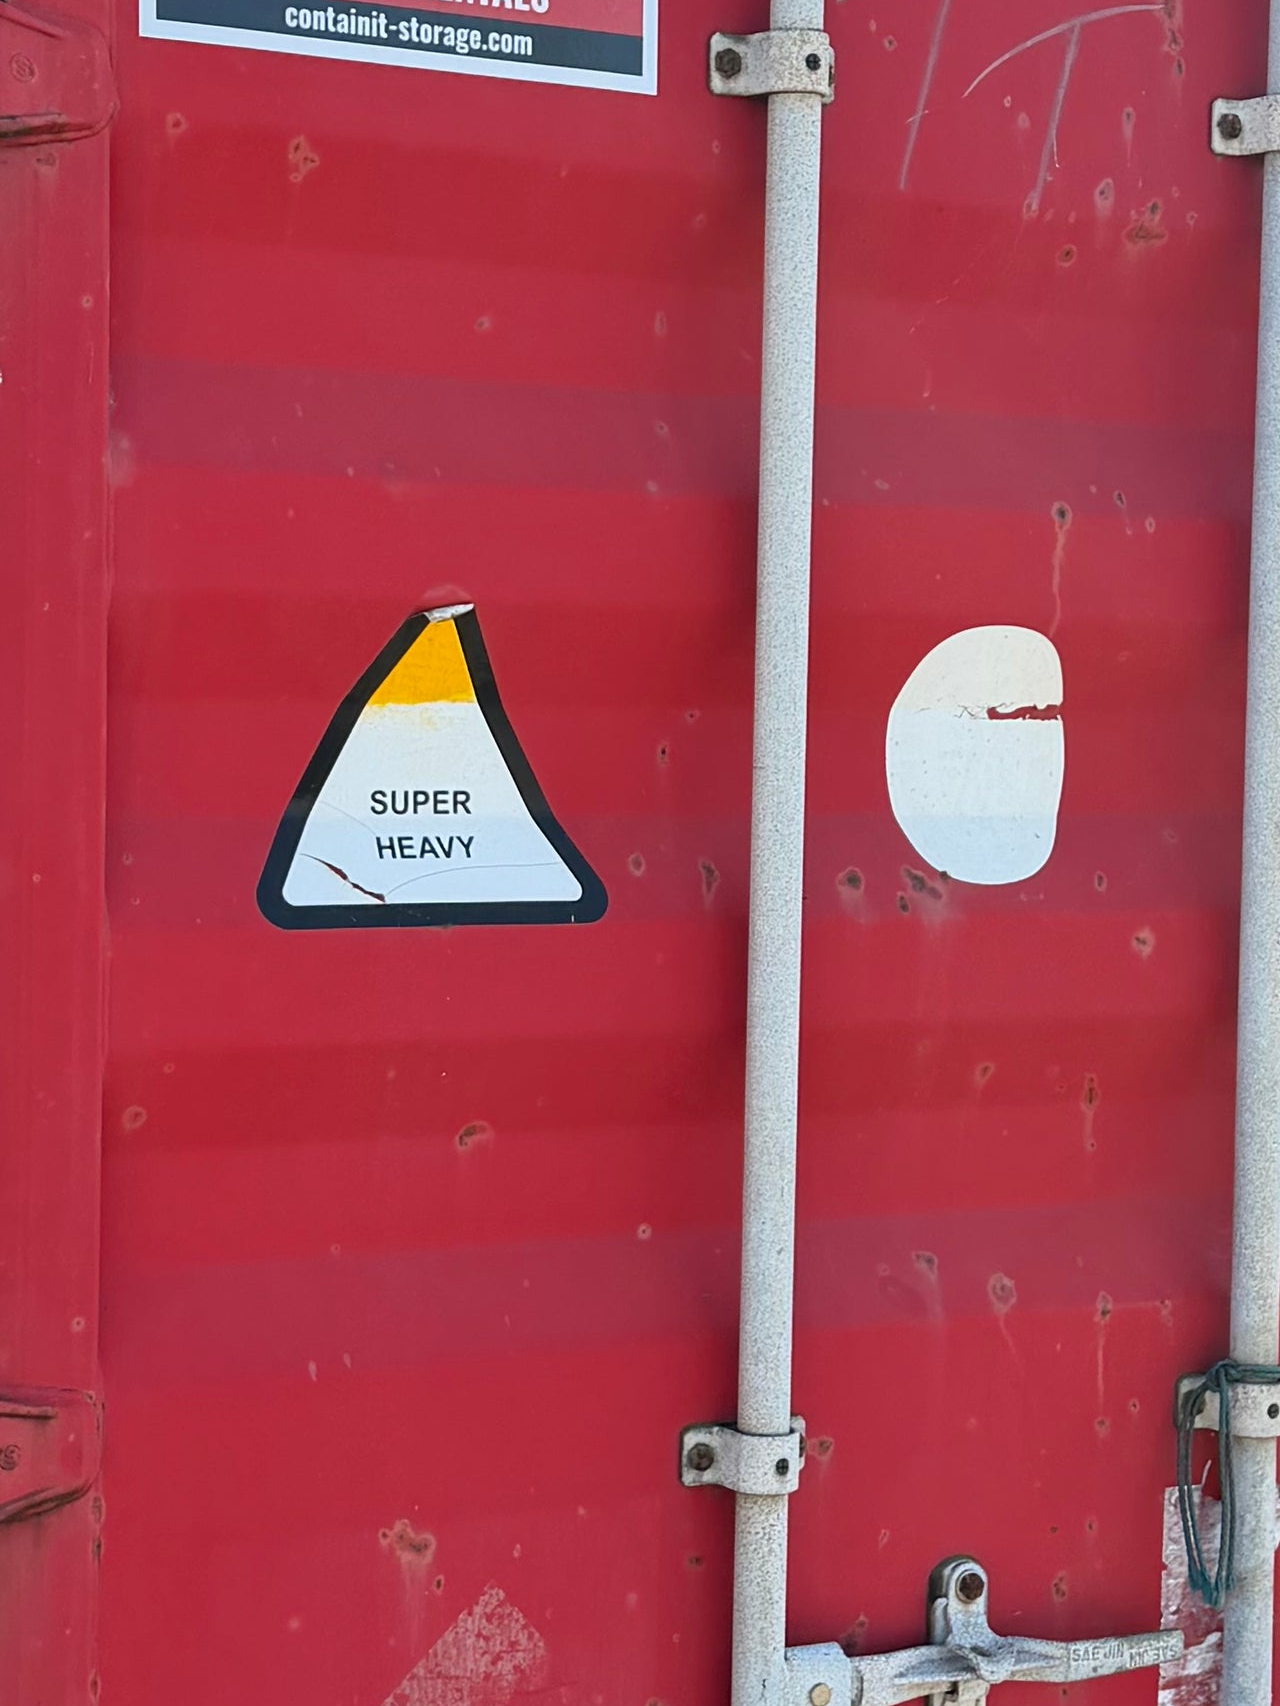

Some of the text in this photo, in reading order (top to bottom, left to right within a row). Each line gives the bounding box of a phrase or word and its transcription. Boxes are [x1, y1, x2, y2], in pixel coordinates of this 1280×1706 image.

[285, 4, 533, 57] containit-storage.com
[370, 789, 472, 816] SUPER
[375, 833, 475, 860] HEAVY
[1072, 1646, 1100, 1663] SAE
